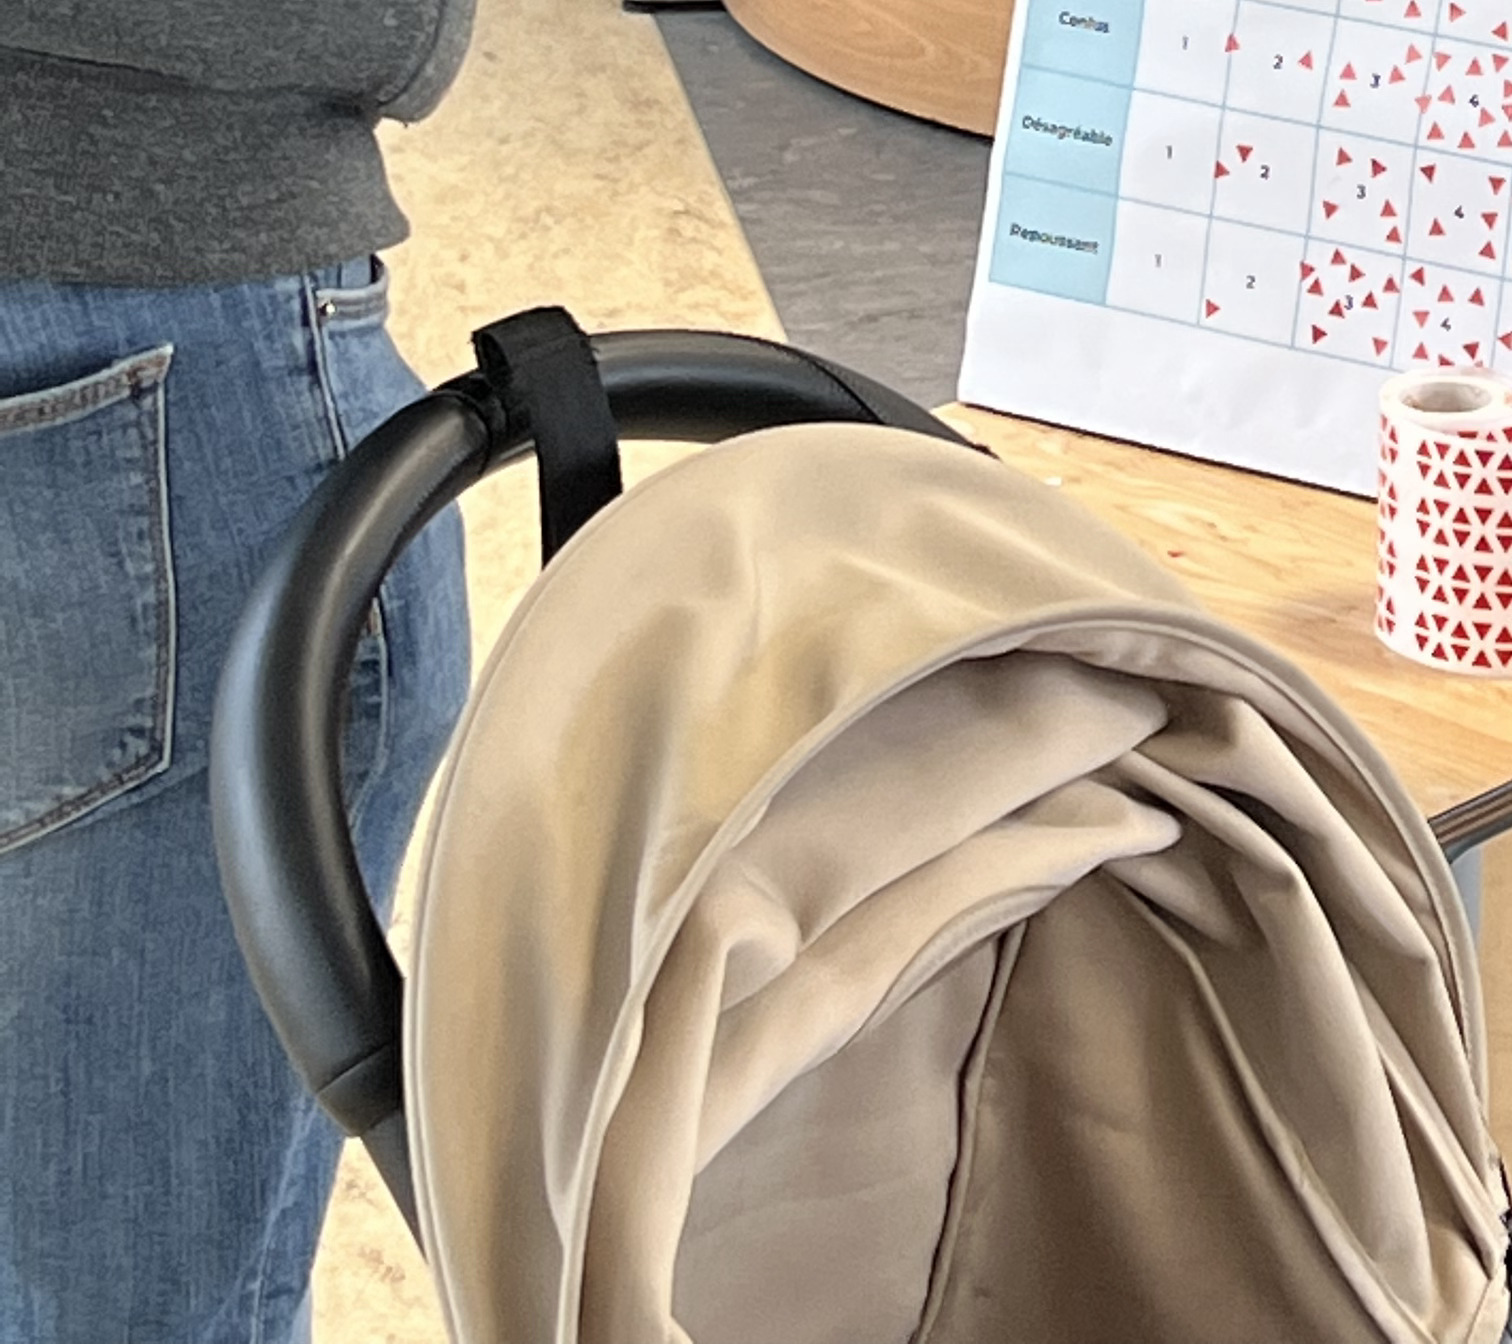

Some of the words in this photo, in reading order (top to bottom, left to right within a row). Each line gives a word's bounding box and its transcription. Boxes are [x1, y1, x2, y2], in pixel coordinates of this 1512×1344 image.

[1058, 10, 1111, 34] Confus
[1181, 35, 1189, 50] 1
[1273, 54, 1284, 70] 2
[1369, 73, 1381, 89] 3
[1468, 94, 1480, 109] 4
[1021, 115, 1114, 147] Désagréable
[1165, 145, 1173, 160] 1
[1260, 164, 1271, 180] 2
[1356, 184, 1367, 200] 3
[1454, 205, 1466, 220] 4
[1009, 222, 1099, 255] Repoussant
[1154, 253, 1162, 268] 1
[1245, 275, 1256, 289] 2
[1344, 294, 1355, 310] 3
[1440, 317, 1452, 332] 4
